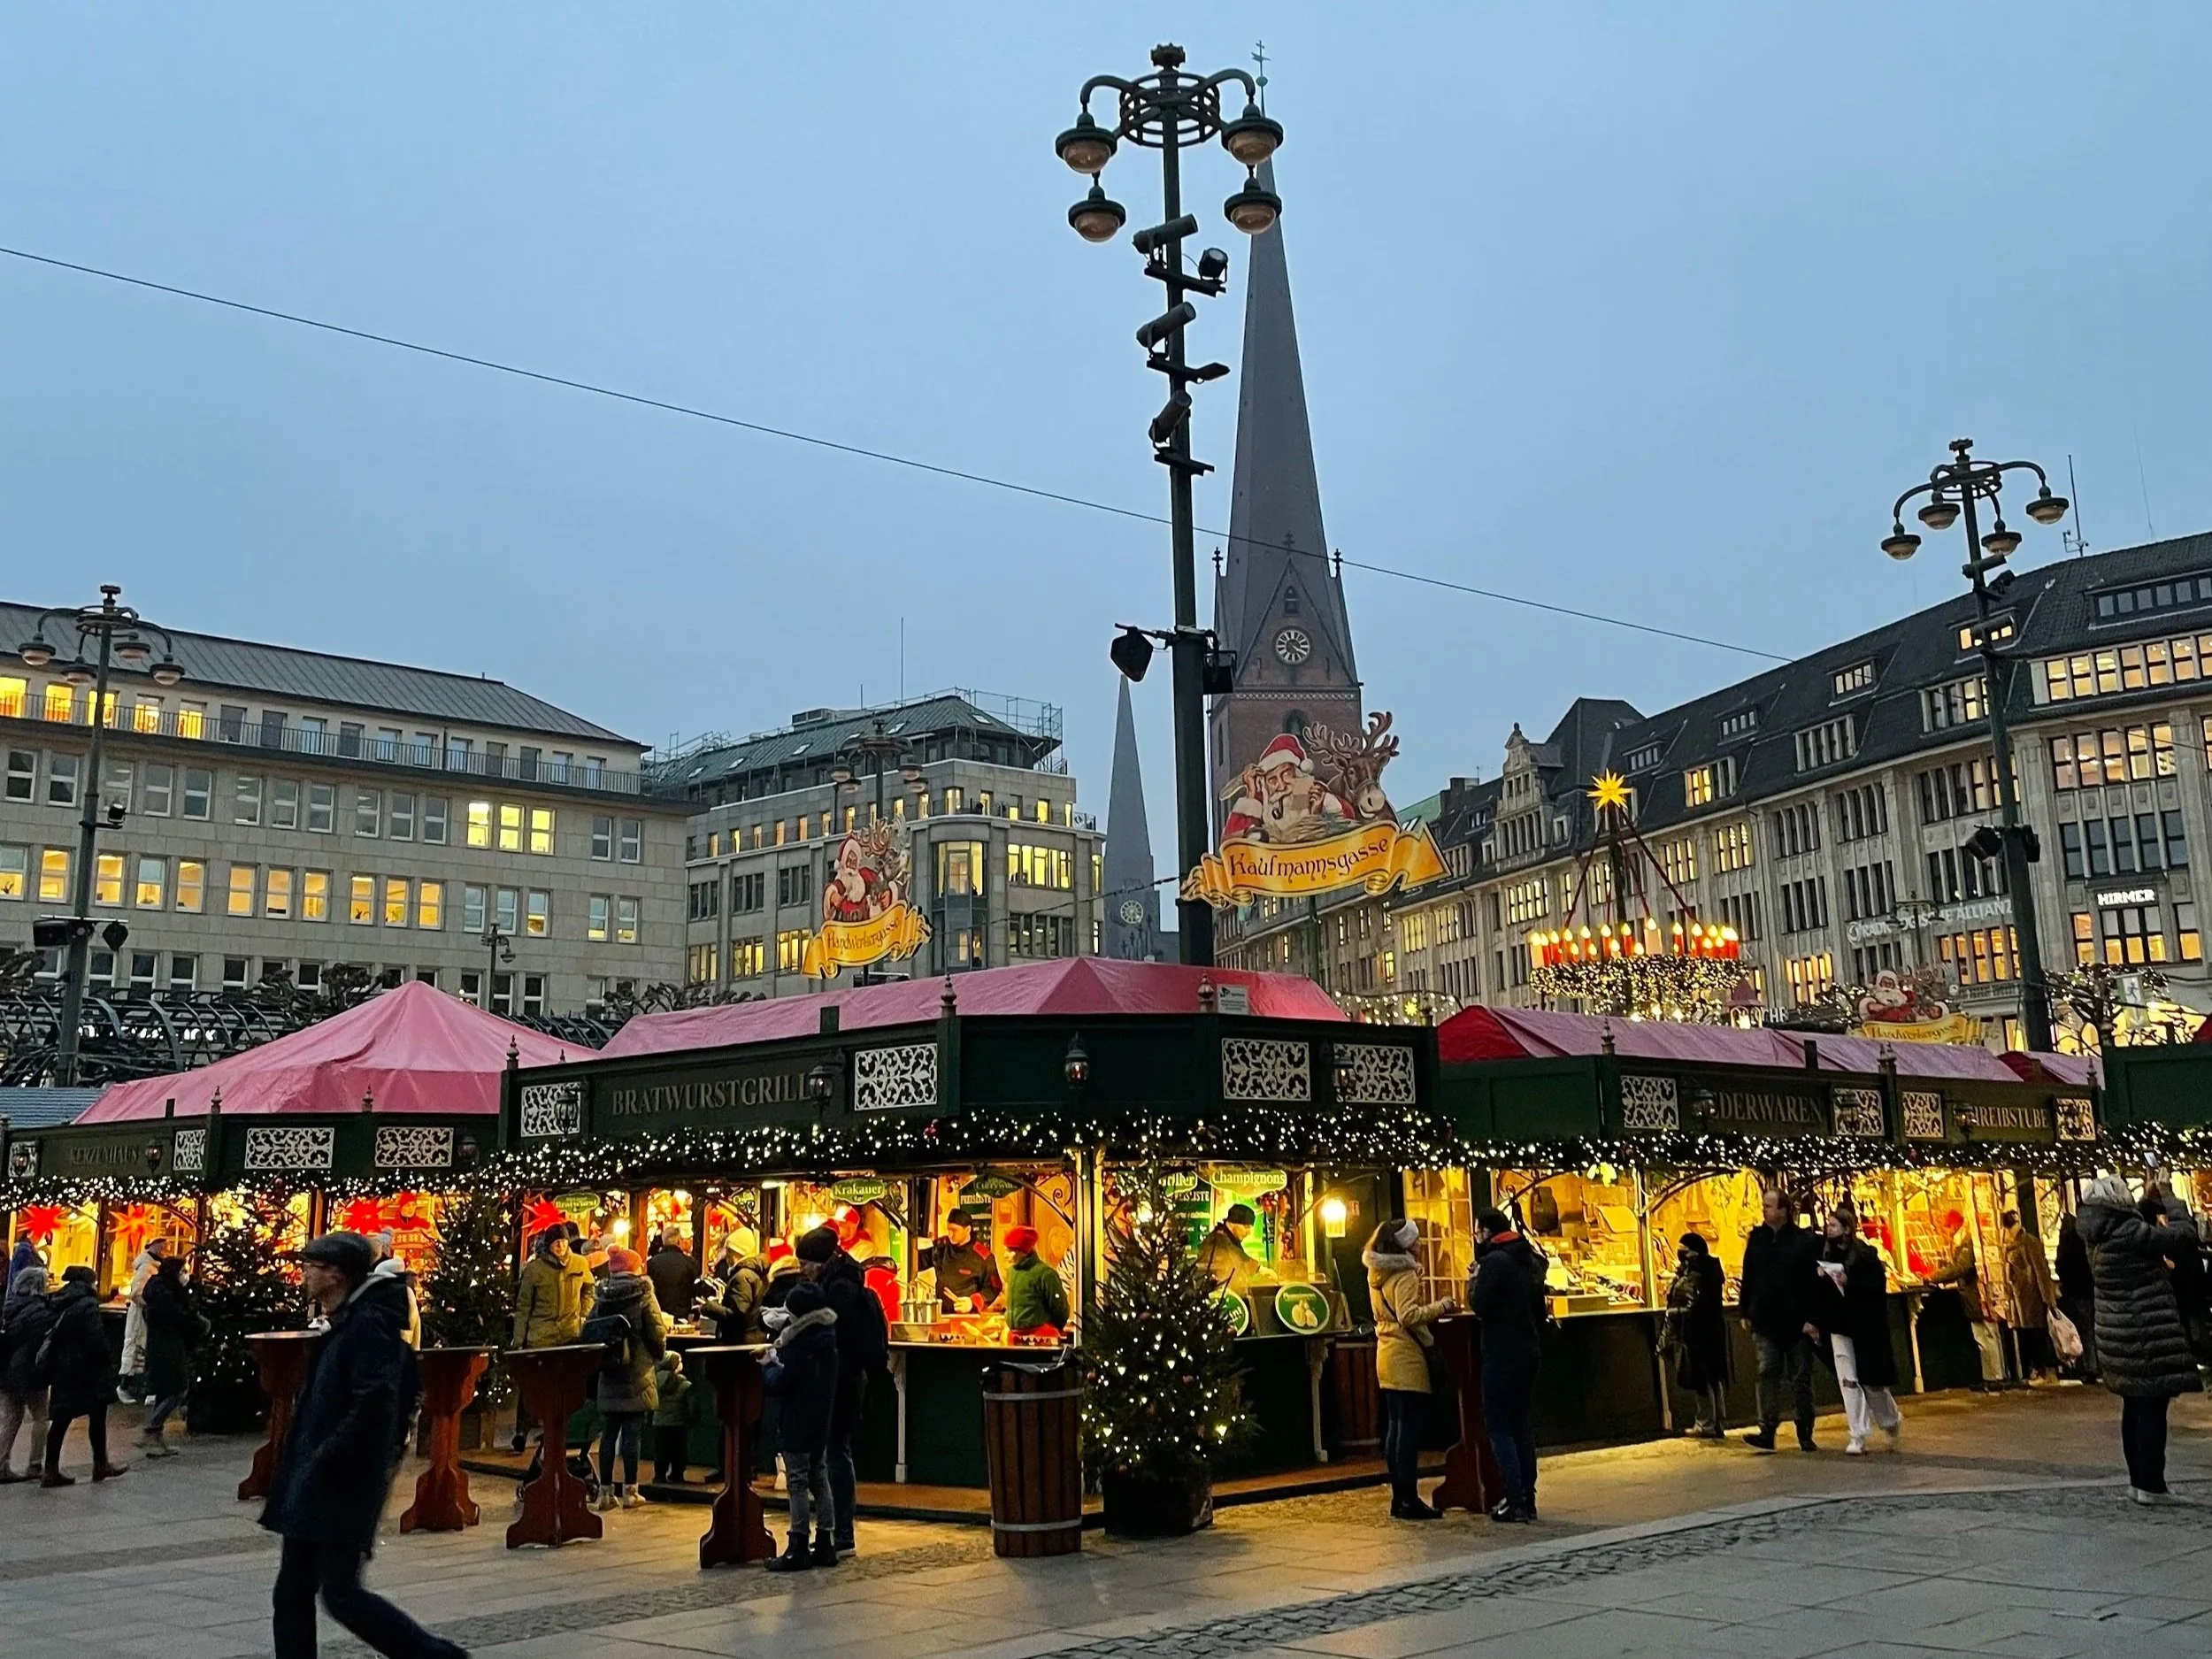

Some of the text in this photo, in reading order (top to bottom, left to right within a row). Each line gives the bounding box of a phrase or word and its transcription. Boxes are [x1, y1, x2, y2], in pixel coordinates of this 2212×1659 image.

[1230, 838, 1388, 883] Kaufmannsgasse
[2097, 889, 2154, 906] HIRMER
[1955, 899, 2013, 921] ALLIANZ
[611, 1072, 811, 1116] BRATWURSTGRILL
[1710, 1091, 1824, 1124] DERWAREN
[834, 1183, 883, 1194] Krakauer
[1212, 1169, 1286, 1187] Champignons
